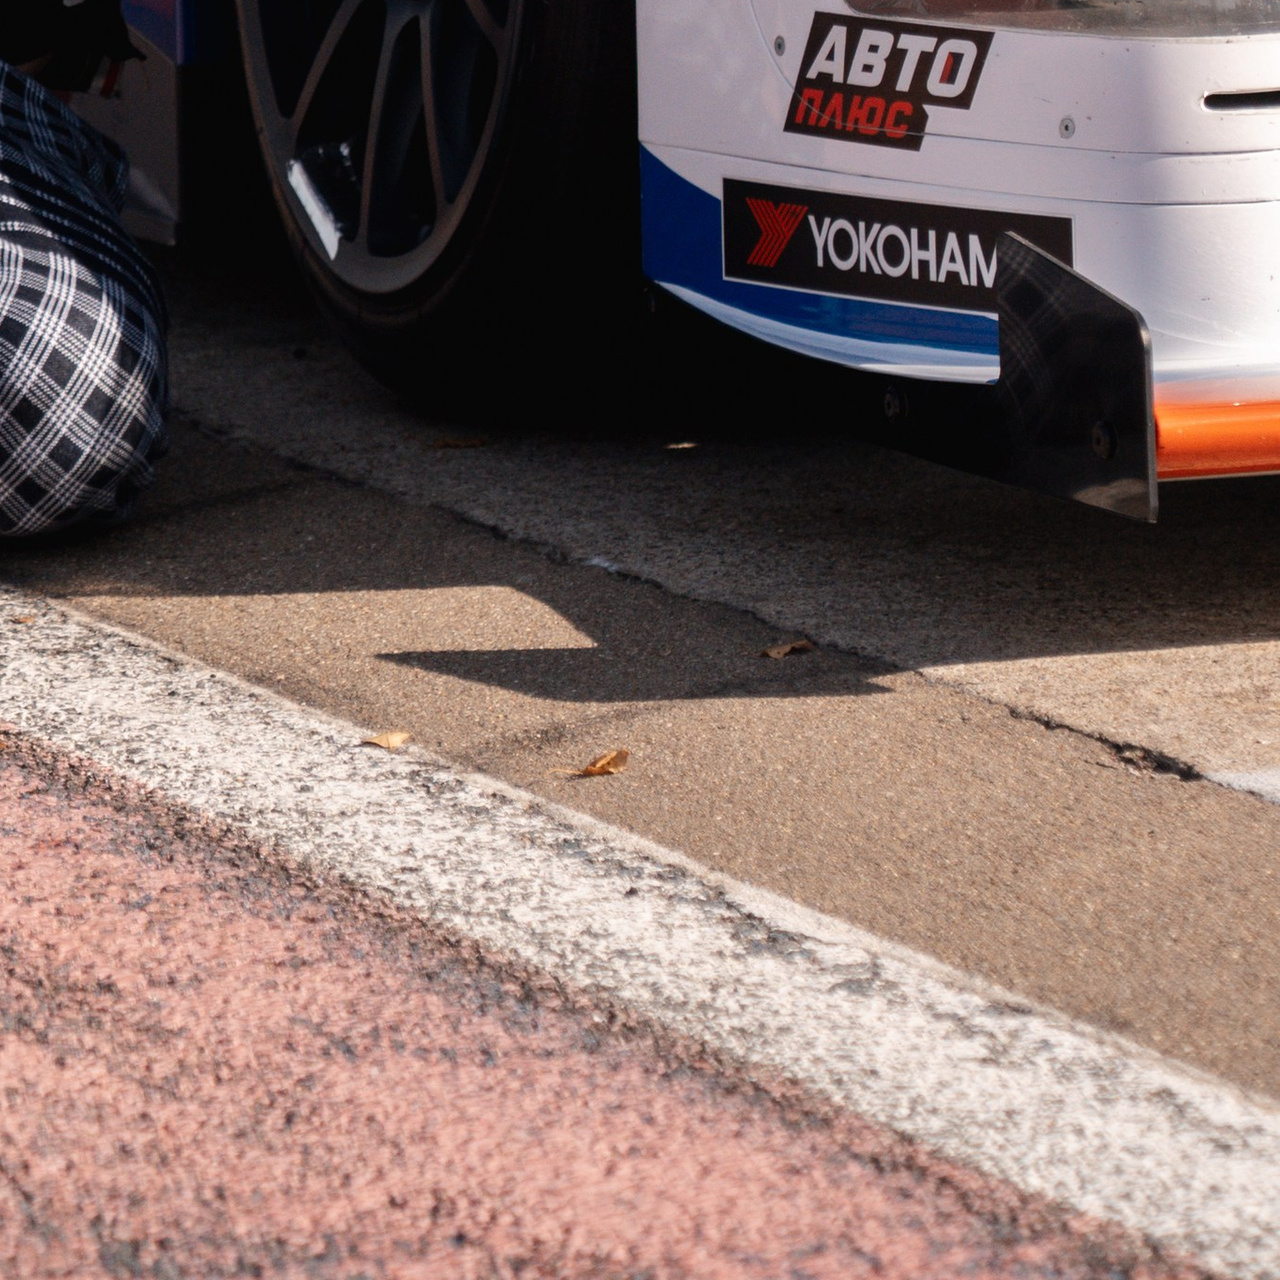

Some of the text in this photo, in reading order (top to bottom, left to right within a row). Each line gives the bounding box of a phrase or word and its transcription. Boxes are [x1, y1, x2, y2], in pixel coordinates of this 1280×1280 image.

[806, 24, 978, 98] АВТО
[794, 89, 914, 139] ПЛЮС
[808, 214, 997, 289] YOKOHAM
